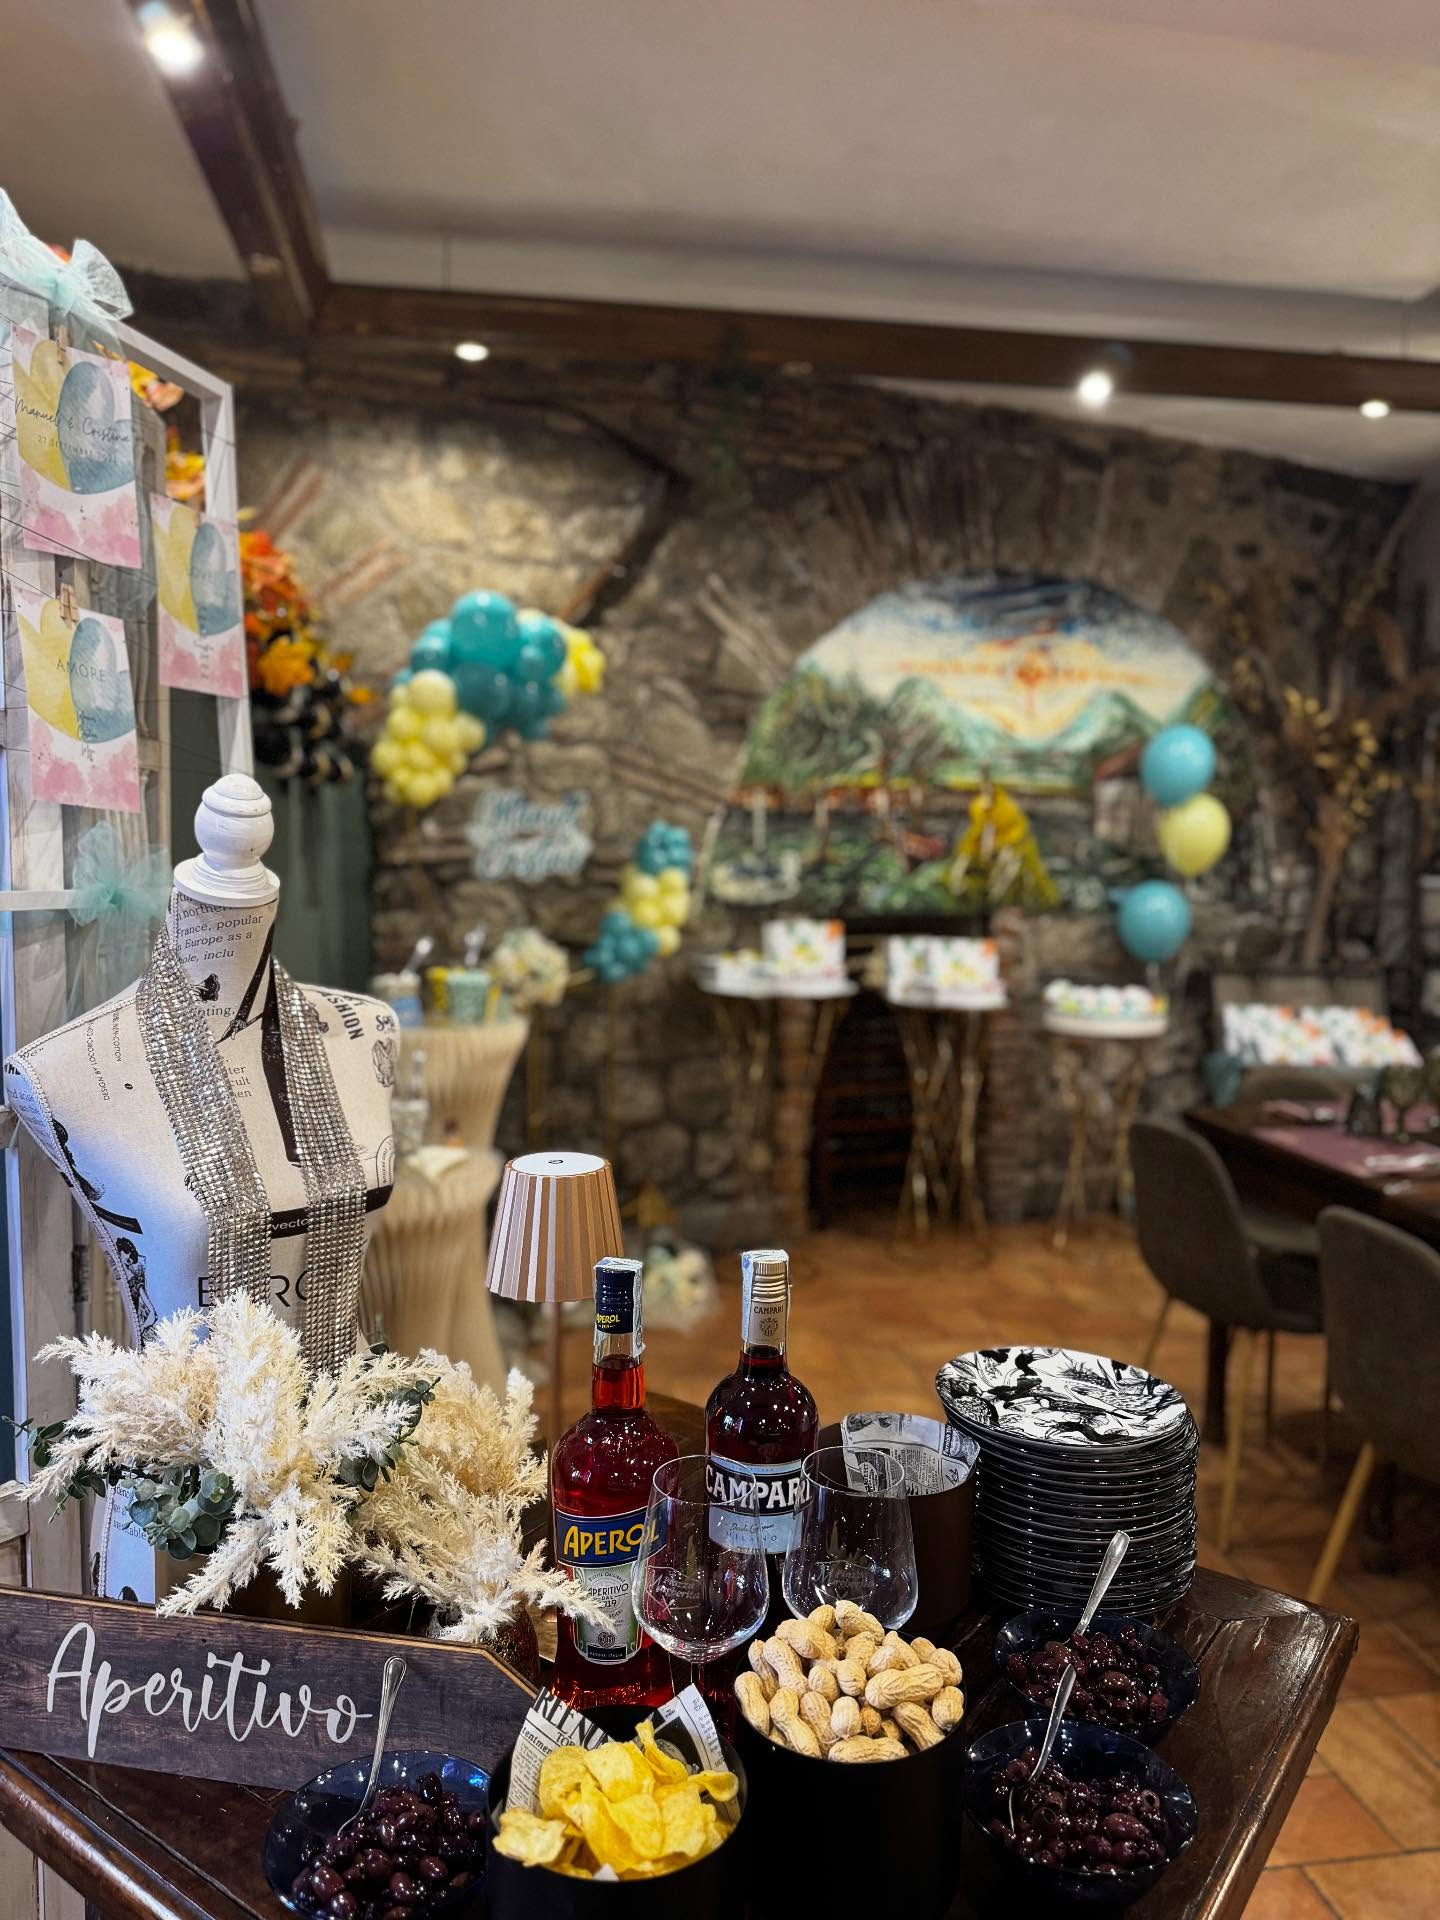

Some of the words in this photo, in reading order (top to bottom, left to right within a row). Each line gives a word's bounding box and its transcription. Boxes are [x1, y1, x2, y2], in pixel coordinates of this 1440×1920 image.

[57, 658, 106, 682] AMORE
[217, 914, 264, 931] popular
[185, 934, 224, 950] Europe
[227, 931, 242, 941] as
[245, 932, 252, 940] a
[203, 947, 235, 961] inclu
[198, 1004, 236, 1018] nting,
[753, 1305, 784, 1315] CAMPARI
[706, 1464, 812, 1510] CAMPARI
[564, 1520, 660, 1558] APEROL
[587, 1582, 629, 1597] APERITIVO
[47, 1622, 373, 1758] Aperitivo
